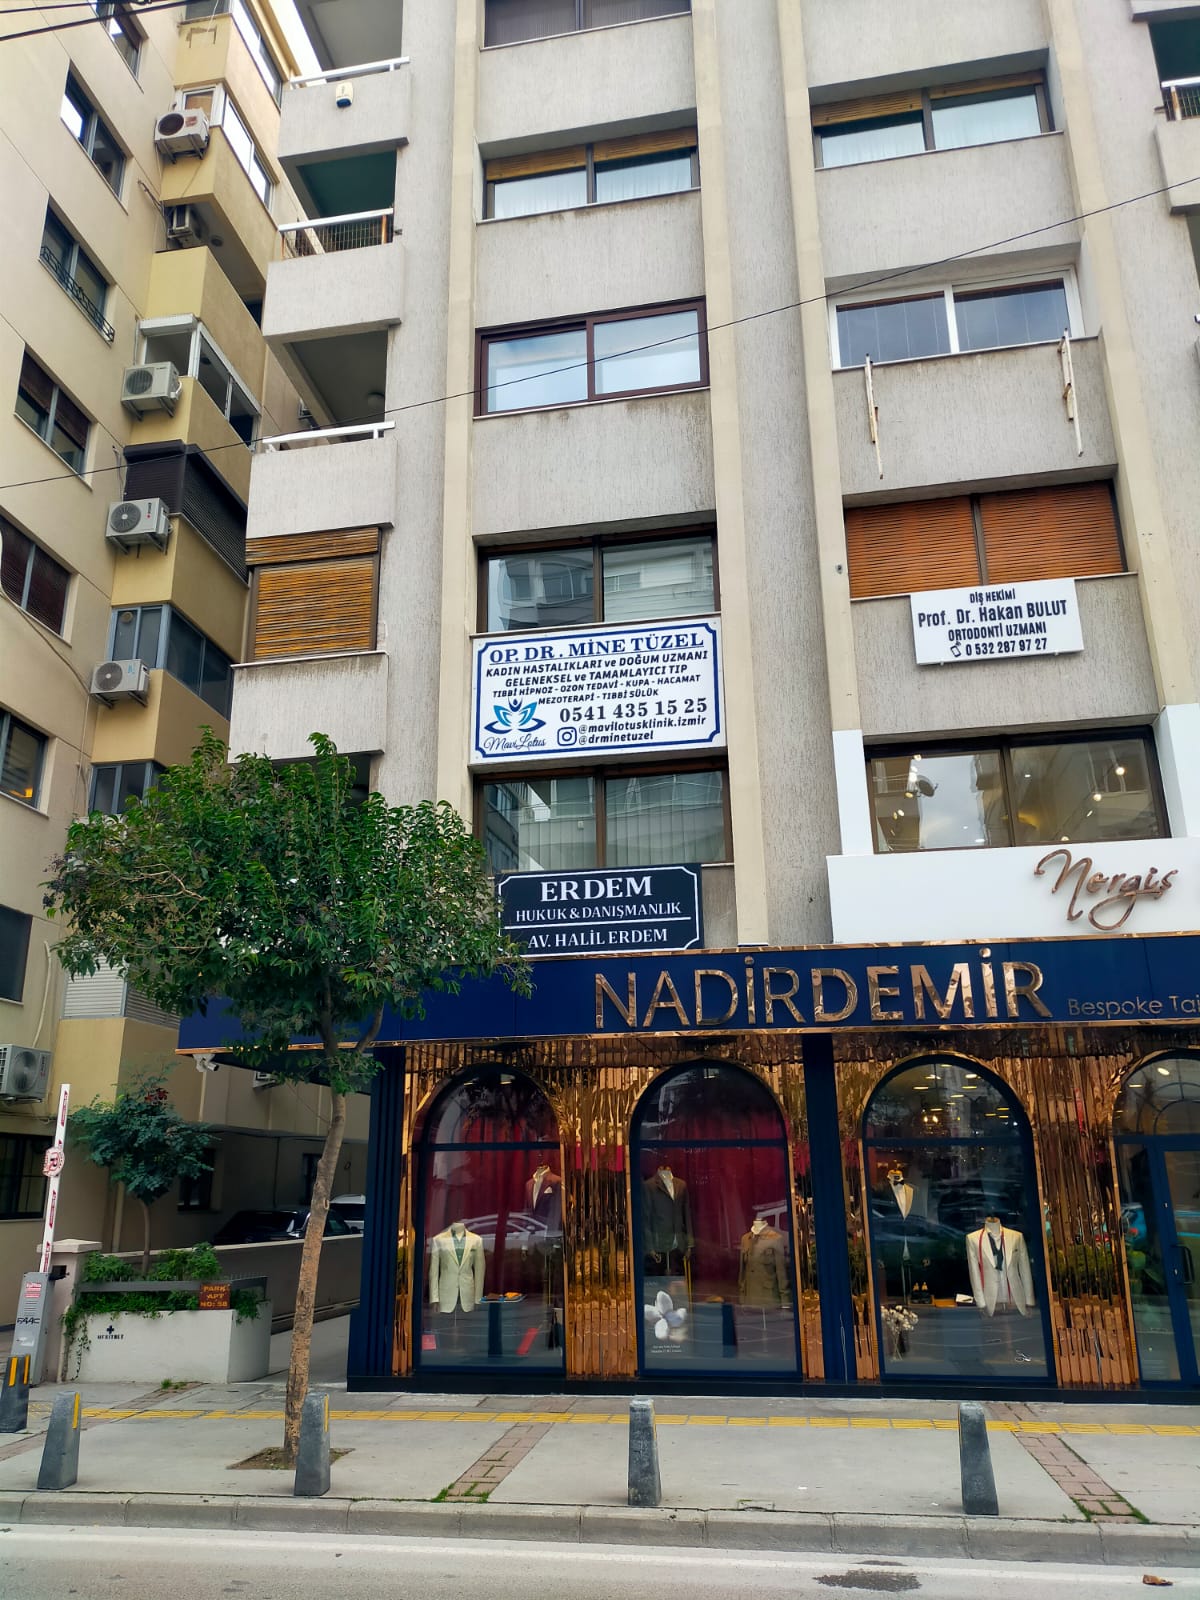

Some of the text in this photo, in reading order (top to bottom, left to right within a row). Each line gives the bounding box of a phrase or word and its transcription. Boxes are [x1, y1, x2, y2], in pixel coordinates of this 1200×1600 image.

[969, 588, 1016, 606] DİŞ HEKİMİ
[918, 599, 1067, 628] Prof. Dr. Hakan BULUT
[948, 621, 1047, 642] ORTODONTİ UZMANI
[489, 649, 519, 663] OP.
[568, 638, 626, 657] MİNE
[630, 632, 704, 651] TÜZEL
[965, 637, 1048, 657] 0 532 287 97 27
[486, 650, 708, 678] KADIN HASTALIKLARI ve DOĞUM UZMANI
[505, 664, 688, 687] GELENEKSEL ve TAMAMLAYICI TIP
[493, 687, 517, 698] TIBBİ
[518, 686, 553, 696] HİPNOZ
[560, 684, 584, 693] OZON
[586, 679, 618, 691] TEDAVİ
[625, 678, 650, 687] KUPA
[657, 674, 701, 685] HACAMAT
[538, 692, 595, 705] MEZOTERAPİ
[602, 690, 628, 700] TIBBİ
[629, 687, 659, 698] SÜLÜK
[559, 697, 708, 722] 0541 435 15 25
[579, 730, 654, 745] @drminetuzel
[540, 875, 653, 902] ERDEM
[1034, 848, 1179, 931] Nergis
[516, 907, 567, 922] HUKUK
[582, 901, 682, 918] DANIŞMANLIK
[527, 928, 668, 949] AV. HALİL ERDEM
[594, 947, 1053, 1029] NADİRDEMİR
[1068, 996, 1163, 1019] Bespoke
[17, 1317, 40, 1325] FAAC
